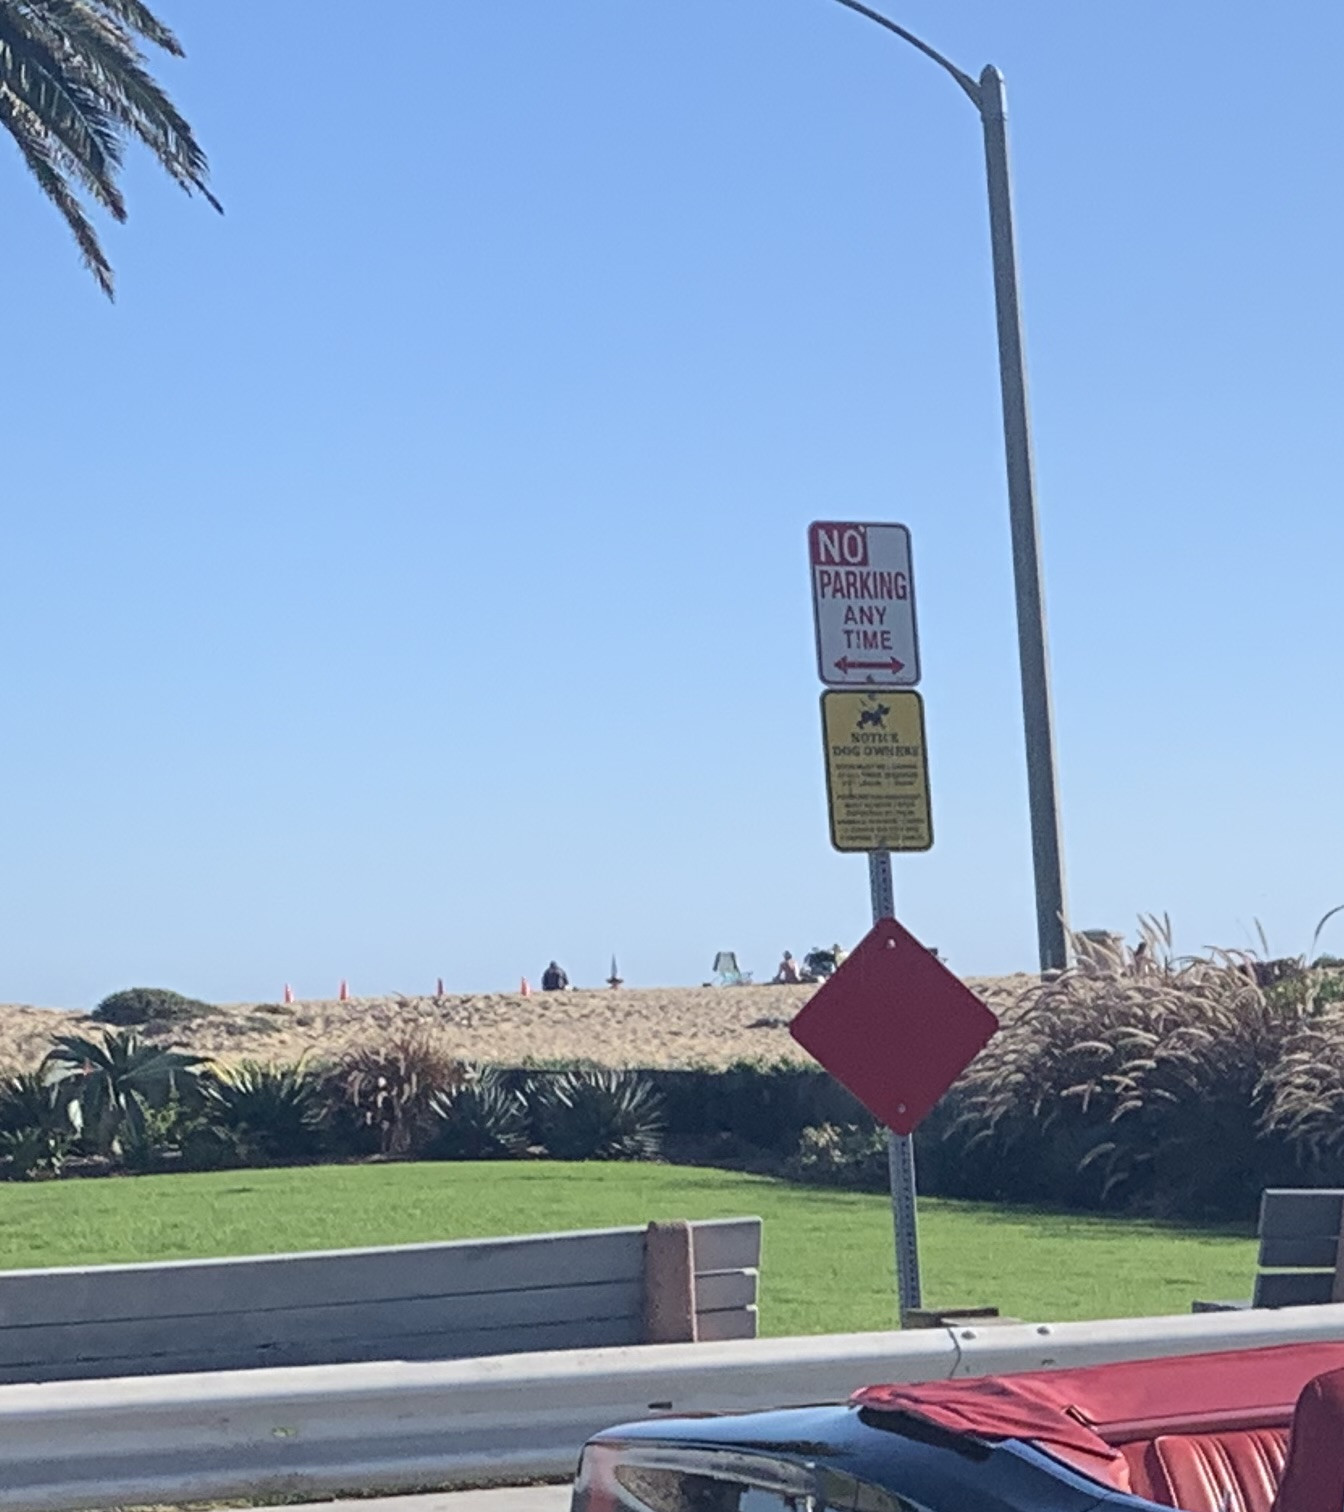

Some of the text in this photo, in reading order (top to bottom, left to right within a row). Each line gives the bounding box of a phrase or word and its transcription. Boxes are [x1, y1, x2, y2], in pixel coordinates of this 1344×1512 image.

[817, 528, 865, 564] NO
[819, 571, 907, 600] PARKING
[843, 605, 887, 626] ANY
[842, 630, 893, 651] TIME
[850, 731, 899, 744] NOTICE
